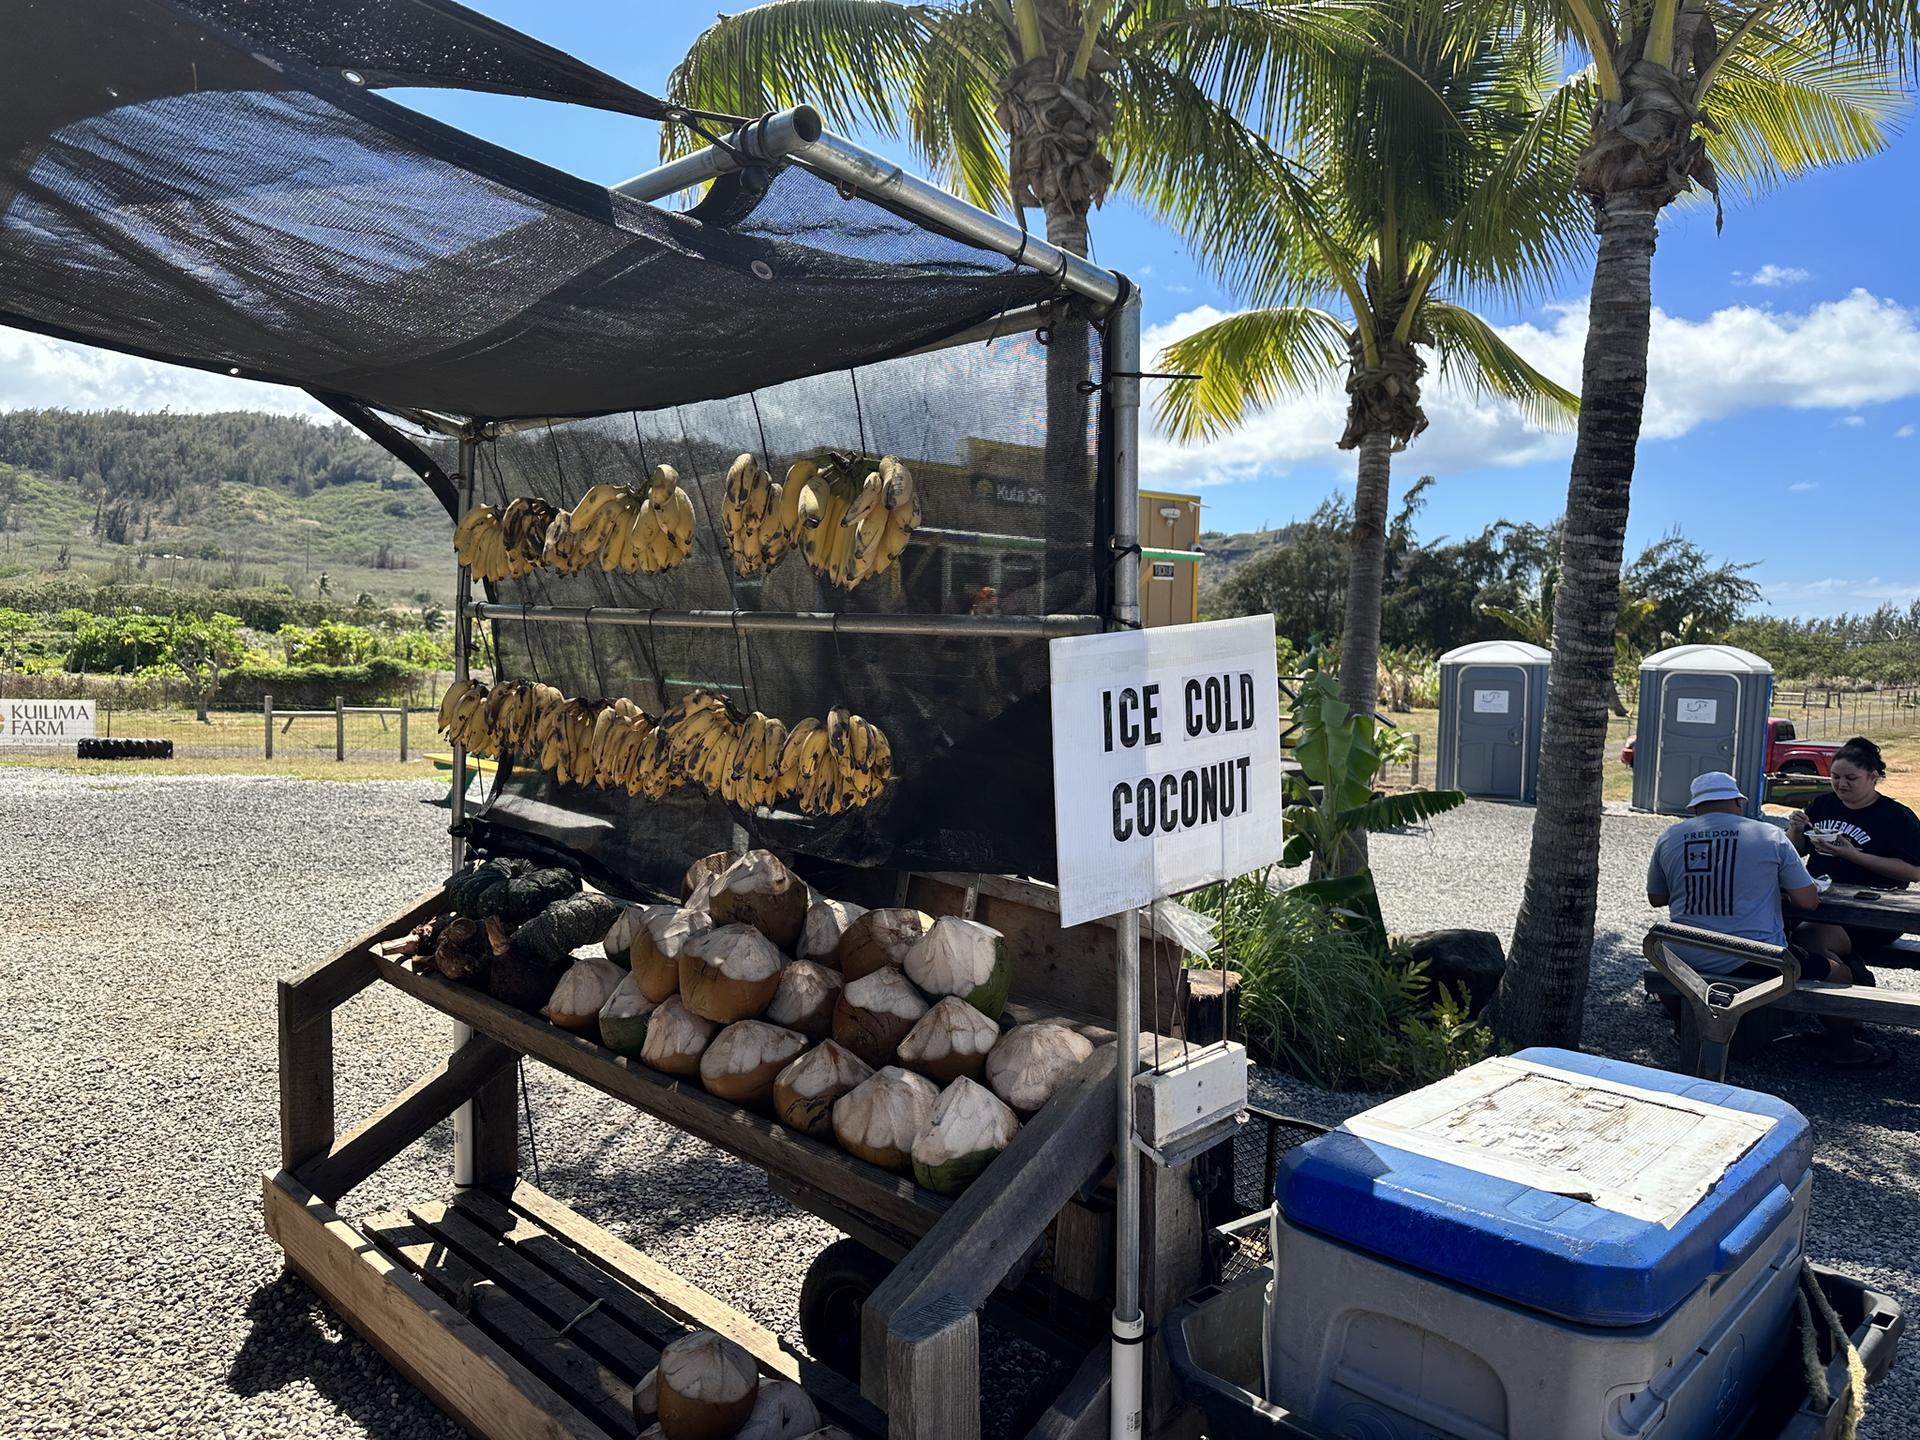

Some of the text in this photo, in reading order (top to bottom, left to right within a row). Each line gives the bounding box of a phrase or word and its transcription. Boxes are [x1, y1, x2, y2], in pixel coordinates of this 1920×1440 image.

[11, 704, 89, 720] KUILIMA
[1102, 673, 1255, 752] ICE COLD
[12, 720, 64, 735] FARM
[1112, 756, 1251, 843] COCONUT
[1683, 830, 1739, 840] FREEDOM
